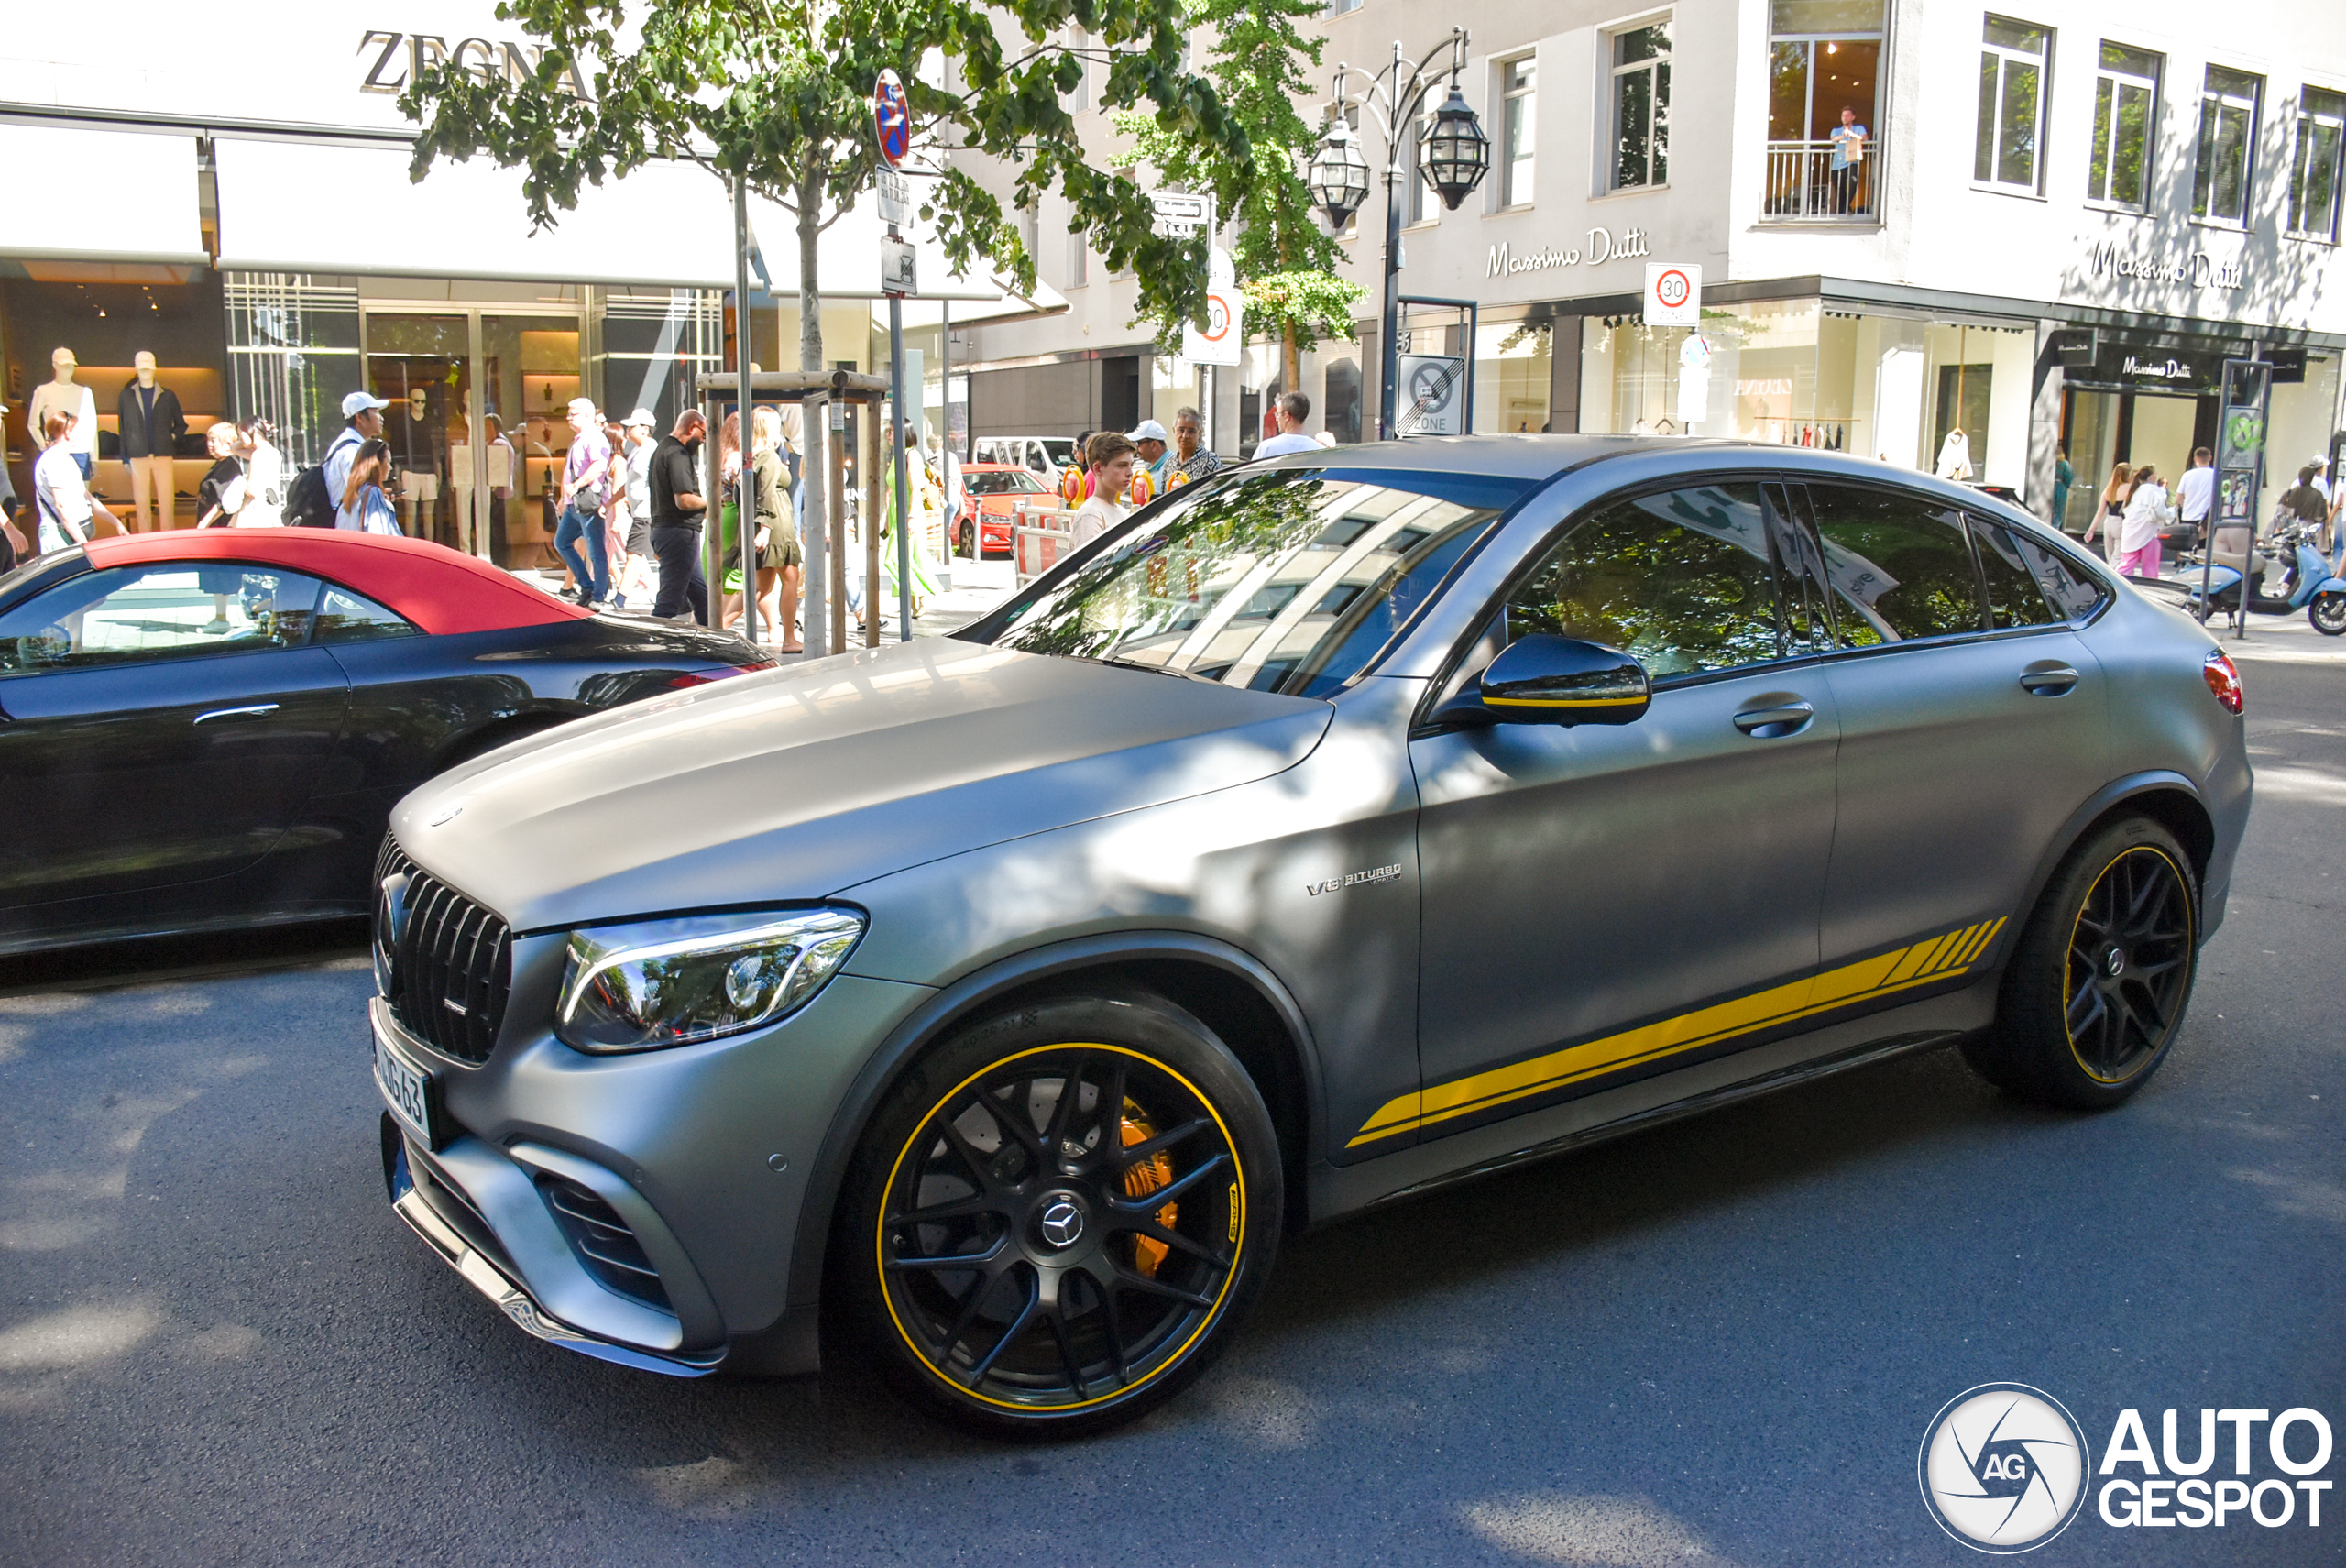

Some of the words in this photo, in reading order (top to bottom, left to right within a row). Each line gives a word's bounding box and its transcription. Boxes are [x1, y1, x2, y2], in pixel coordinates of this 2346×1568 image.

[1486, 241, 1582, 279] Massimo
[1586, 227, 1651, 266] Dutti
[2091, 239, 2187, 283] Massimo
[2191, 251, 2243, 290] Dutti
[1662, 280, 1683, 298] 30
[1660, 310, 1684, 321] ZONE
[2122, 356, 2165, 376] Massimo
[2166, 359, 2191, 378] Dutti
[1414, 417, 1446, 431] ZONE
[1306, 878, 1343, 896] V8
[1344, 863, 1401, 884] BITURBO
[401, 1069, 422, 1124] 63
